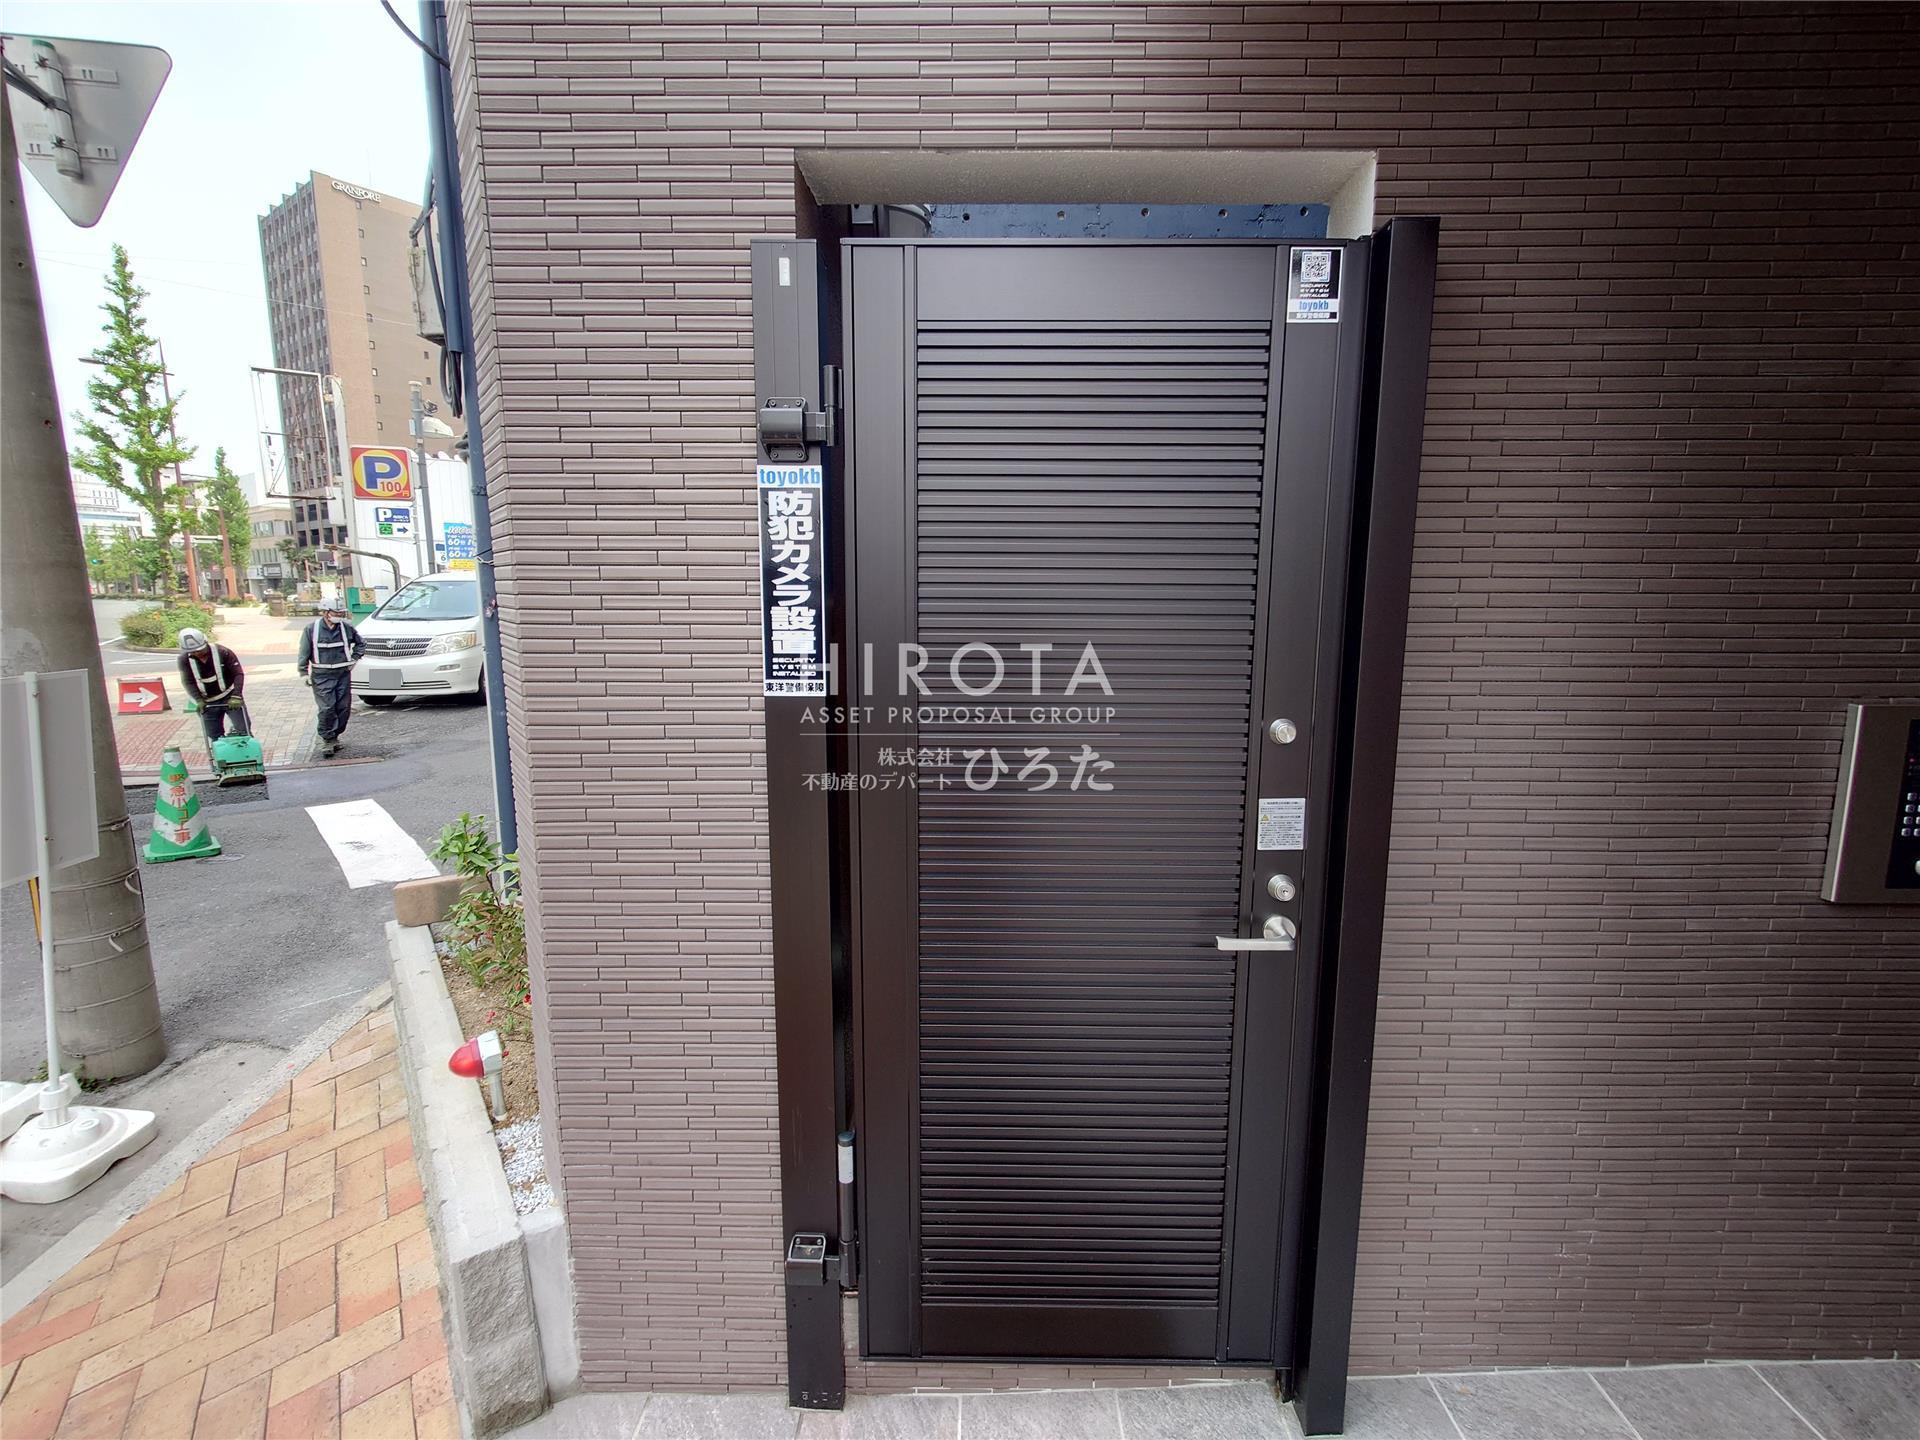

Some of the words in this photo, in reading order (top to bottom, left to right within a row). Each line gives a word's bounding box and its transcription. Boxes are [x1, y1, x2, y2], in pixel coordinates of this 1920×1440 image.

[331, 181, 382, 203] GRANFORE
[1299, 300, 1329, 311] toyokb
[362, 455, 401, 489] P
[759, 468, 820, 487] toyokb
[377, 508, 392, 521] P
[767, 490, 817, 655] 防犯カメラ設置
[765, 682, 824, 693] 東洋警備保障
